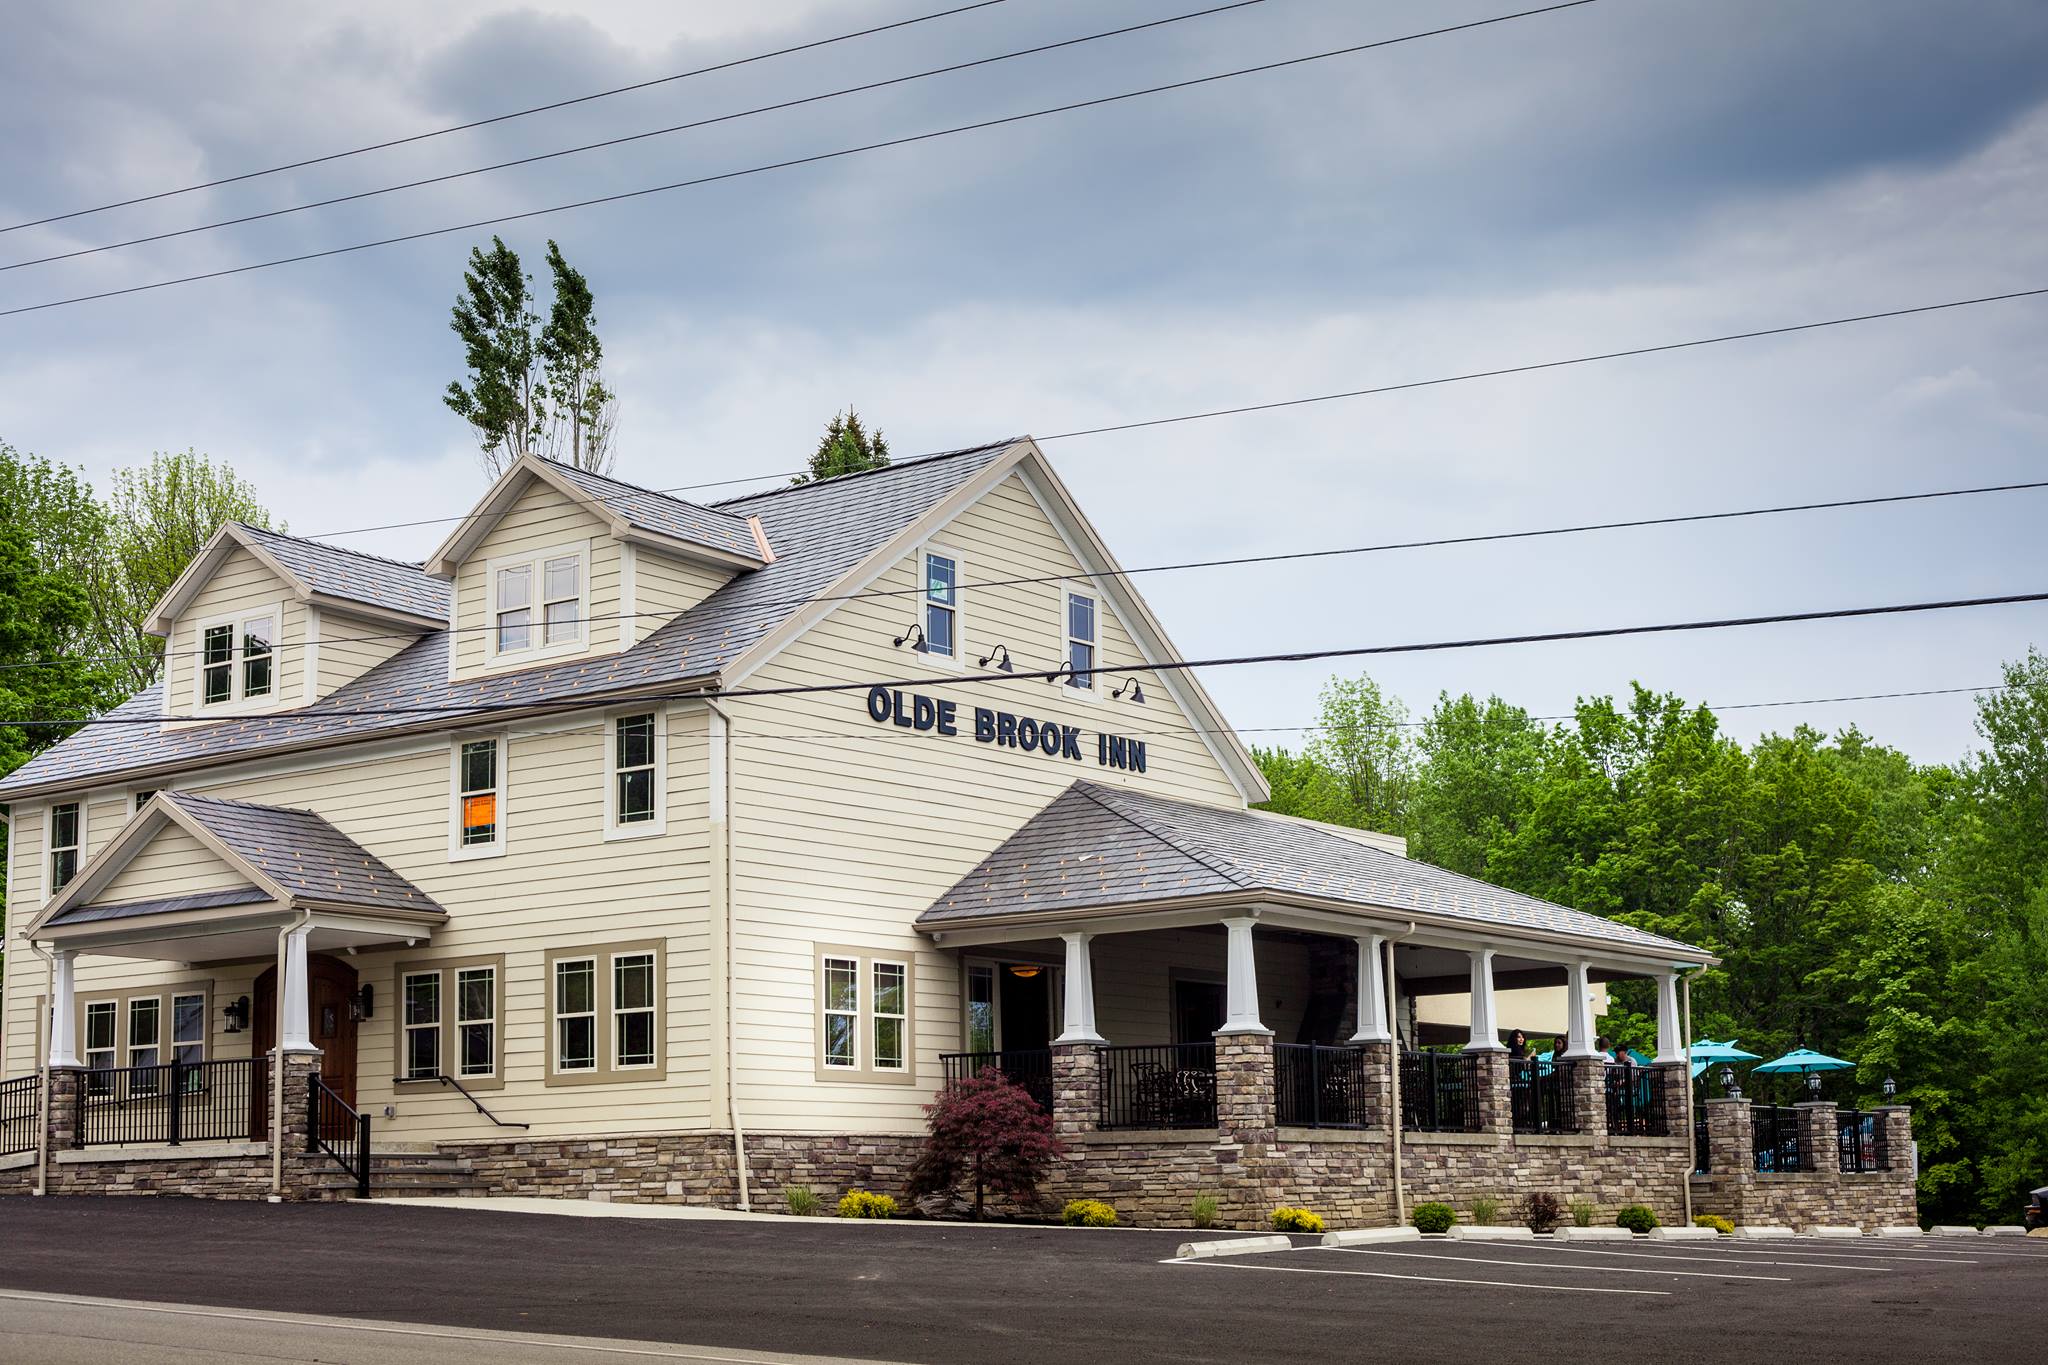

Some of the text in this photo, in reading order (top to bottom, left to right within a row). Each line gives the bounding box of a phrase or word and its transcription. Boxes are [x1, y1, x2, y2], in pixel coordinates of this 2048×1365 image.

[868, 686, 1147, 773] OLDE BROOK INN
